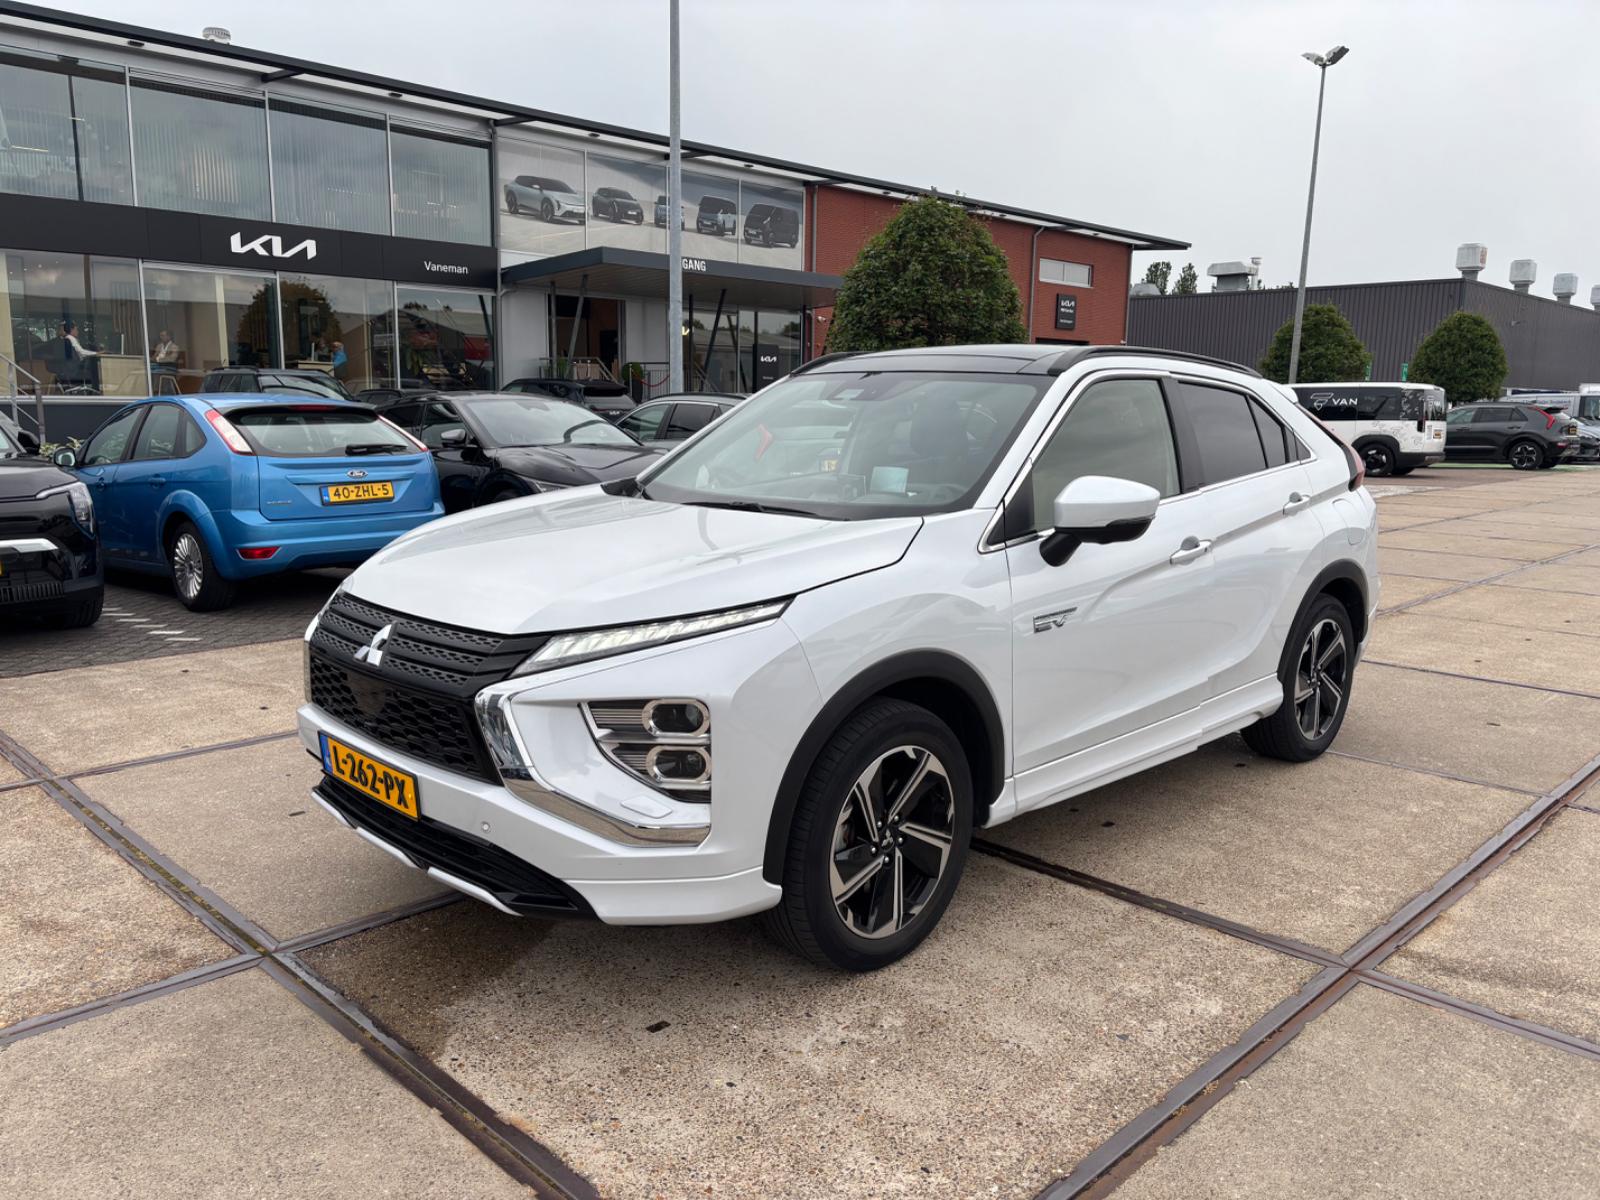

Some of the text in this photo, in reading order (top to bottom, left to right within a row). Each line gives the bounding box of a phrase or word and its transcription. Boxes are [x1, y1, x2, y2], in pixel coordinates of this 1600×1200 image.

[230, 232, 317, 260] KIA
[424, 261, 469, 275] Vaneman
[682, 258, 707, 271] GANG
[1332, 398, 1358, 406] VAN
[333, 484, 389, 499] 40-ZHL-5
[333, 745, 409, 809] L-262-PX
